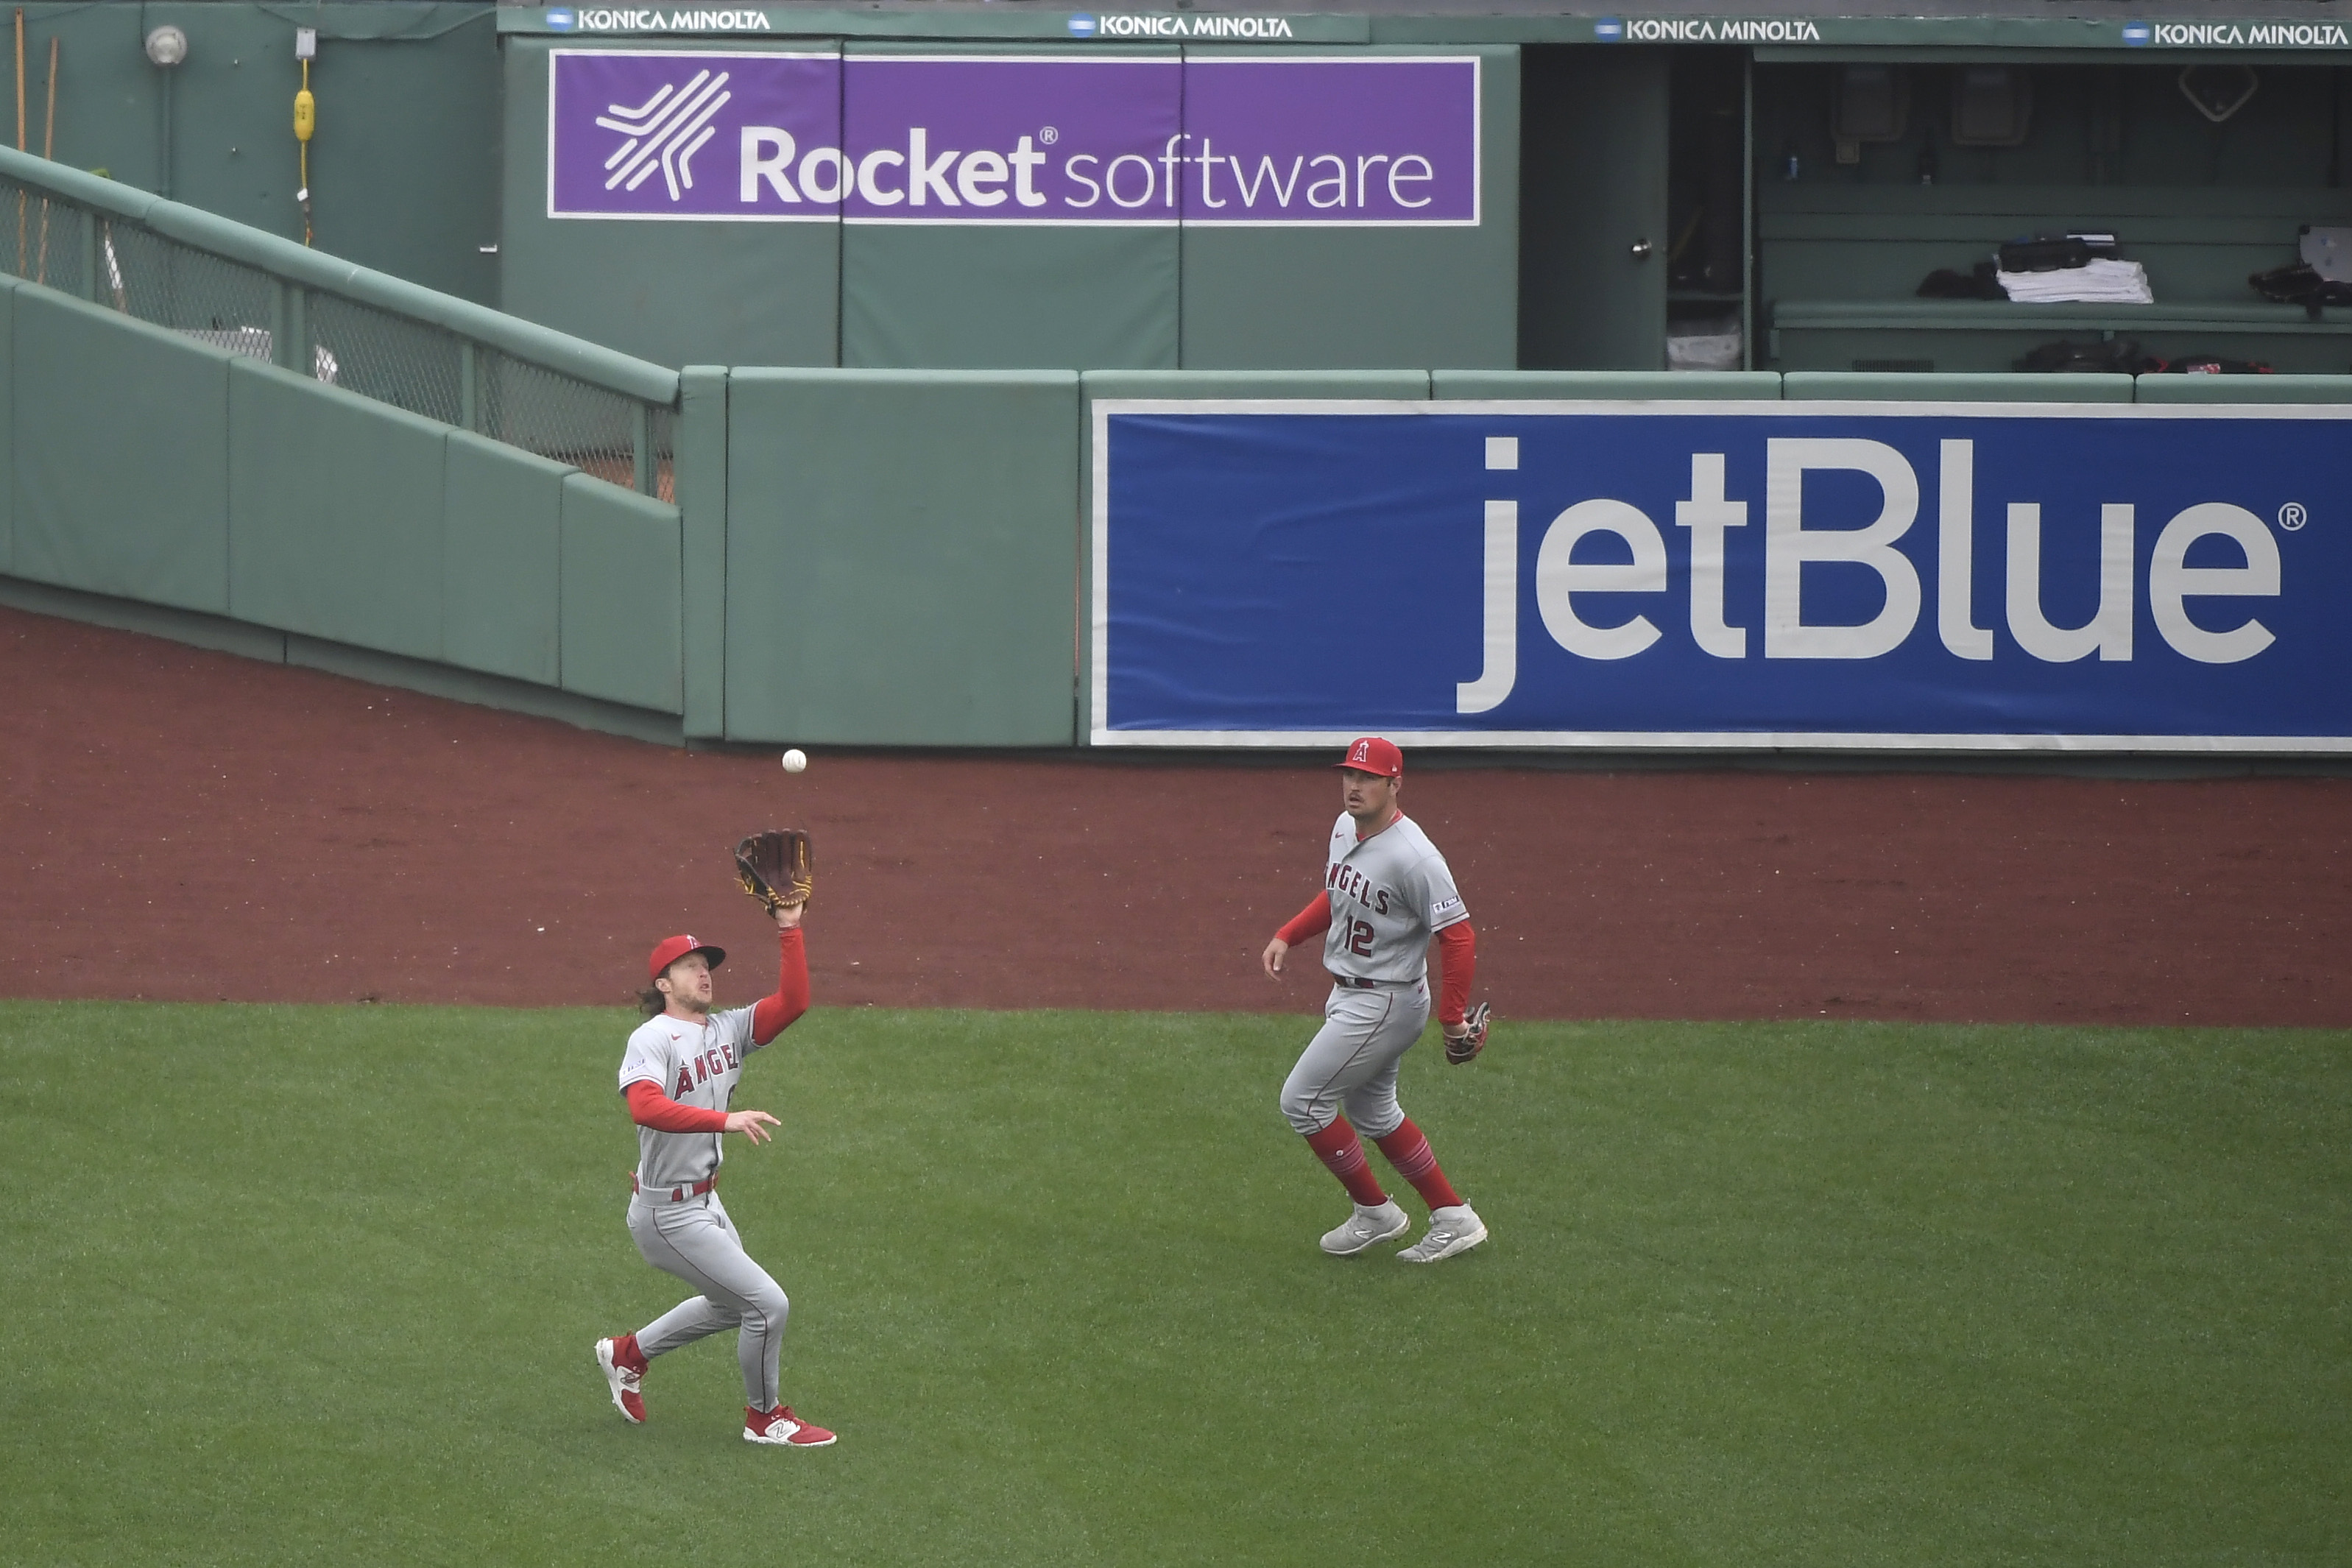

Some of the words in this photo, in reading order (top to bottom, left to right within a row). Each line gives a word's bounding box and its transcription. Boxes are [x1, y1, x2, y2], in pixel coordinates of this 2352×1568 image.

[578, 10, 667, 30] KONICA
[670, 10, 771, 31] MINOLTA
[1100, 15, 1190, 36] KONICA
[1193, 17, 1293, 38] MINOLTA
[1627, 21, 1716, 40] KONICA
[1720, 21, 1820, 40] MINOLTA
[2155, 24, 2245, 44] KONICA
[2247, 25, 2349, 45] MINOLTA
[1064, 133, 1433, 208] software
[1352, 740, 1369, 763] A
[1324, 861, 1390, 916] NGELS
[1343, 915, 1375, 958] 12
